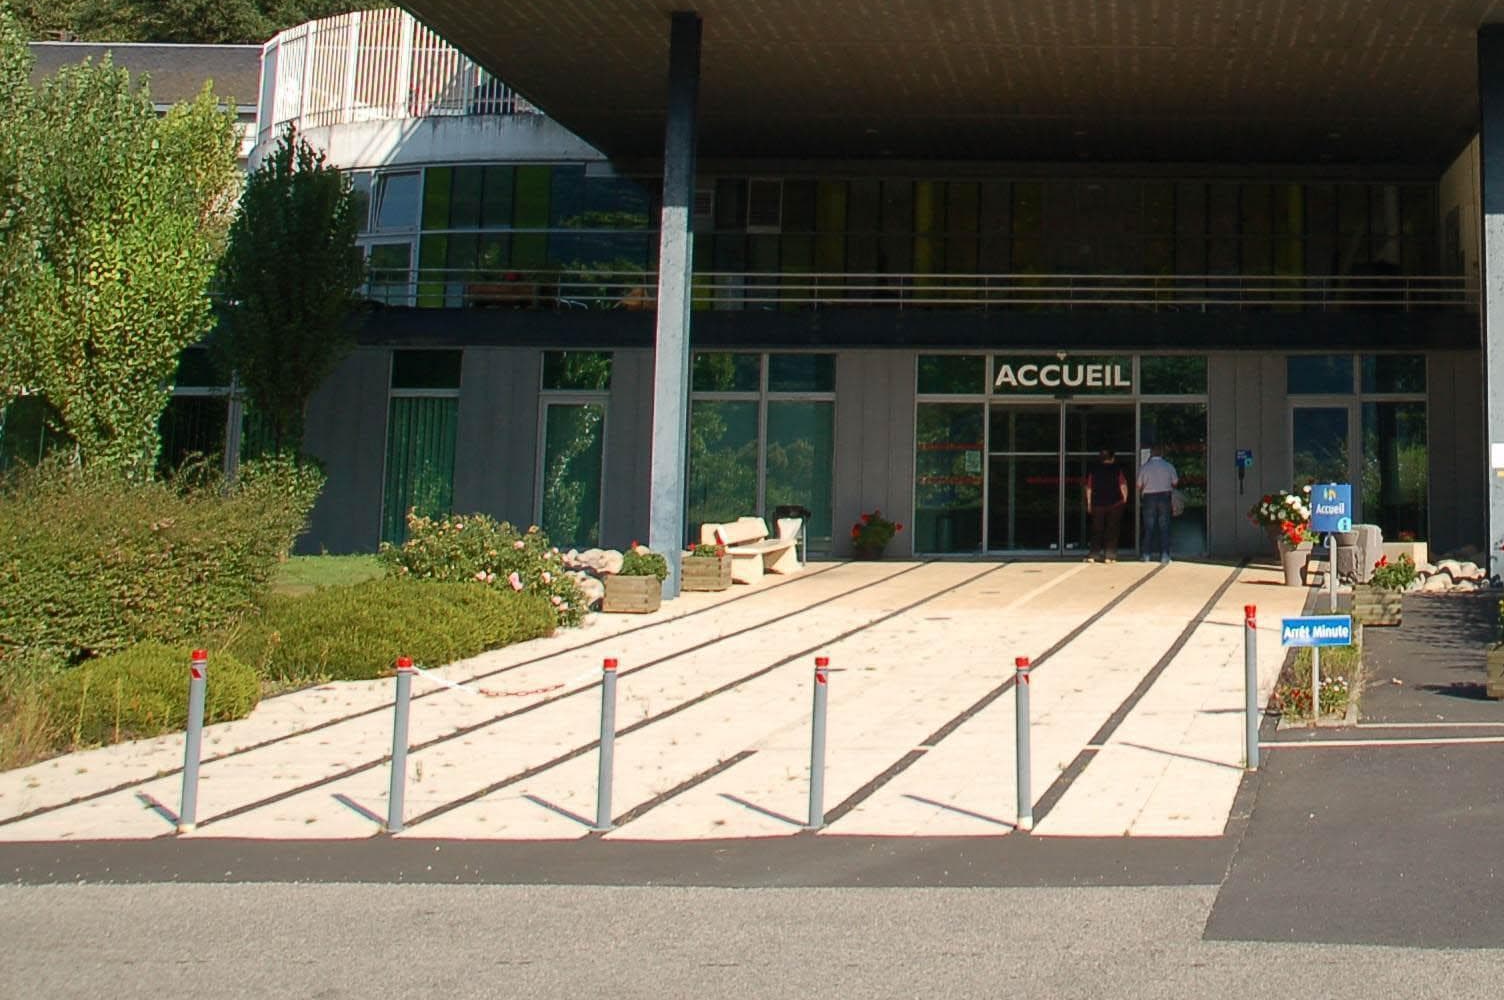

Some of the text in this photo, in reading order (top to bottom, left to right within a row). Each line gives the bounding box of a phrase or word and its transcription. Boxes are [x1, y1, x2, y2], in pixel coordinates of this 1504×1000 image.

[995, 364, 1132, 387] ACCUEIL
[1315, 502, 1345, 515] Accueil
[1312, 624, 1349, 639] Minute
